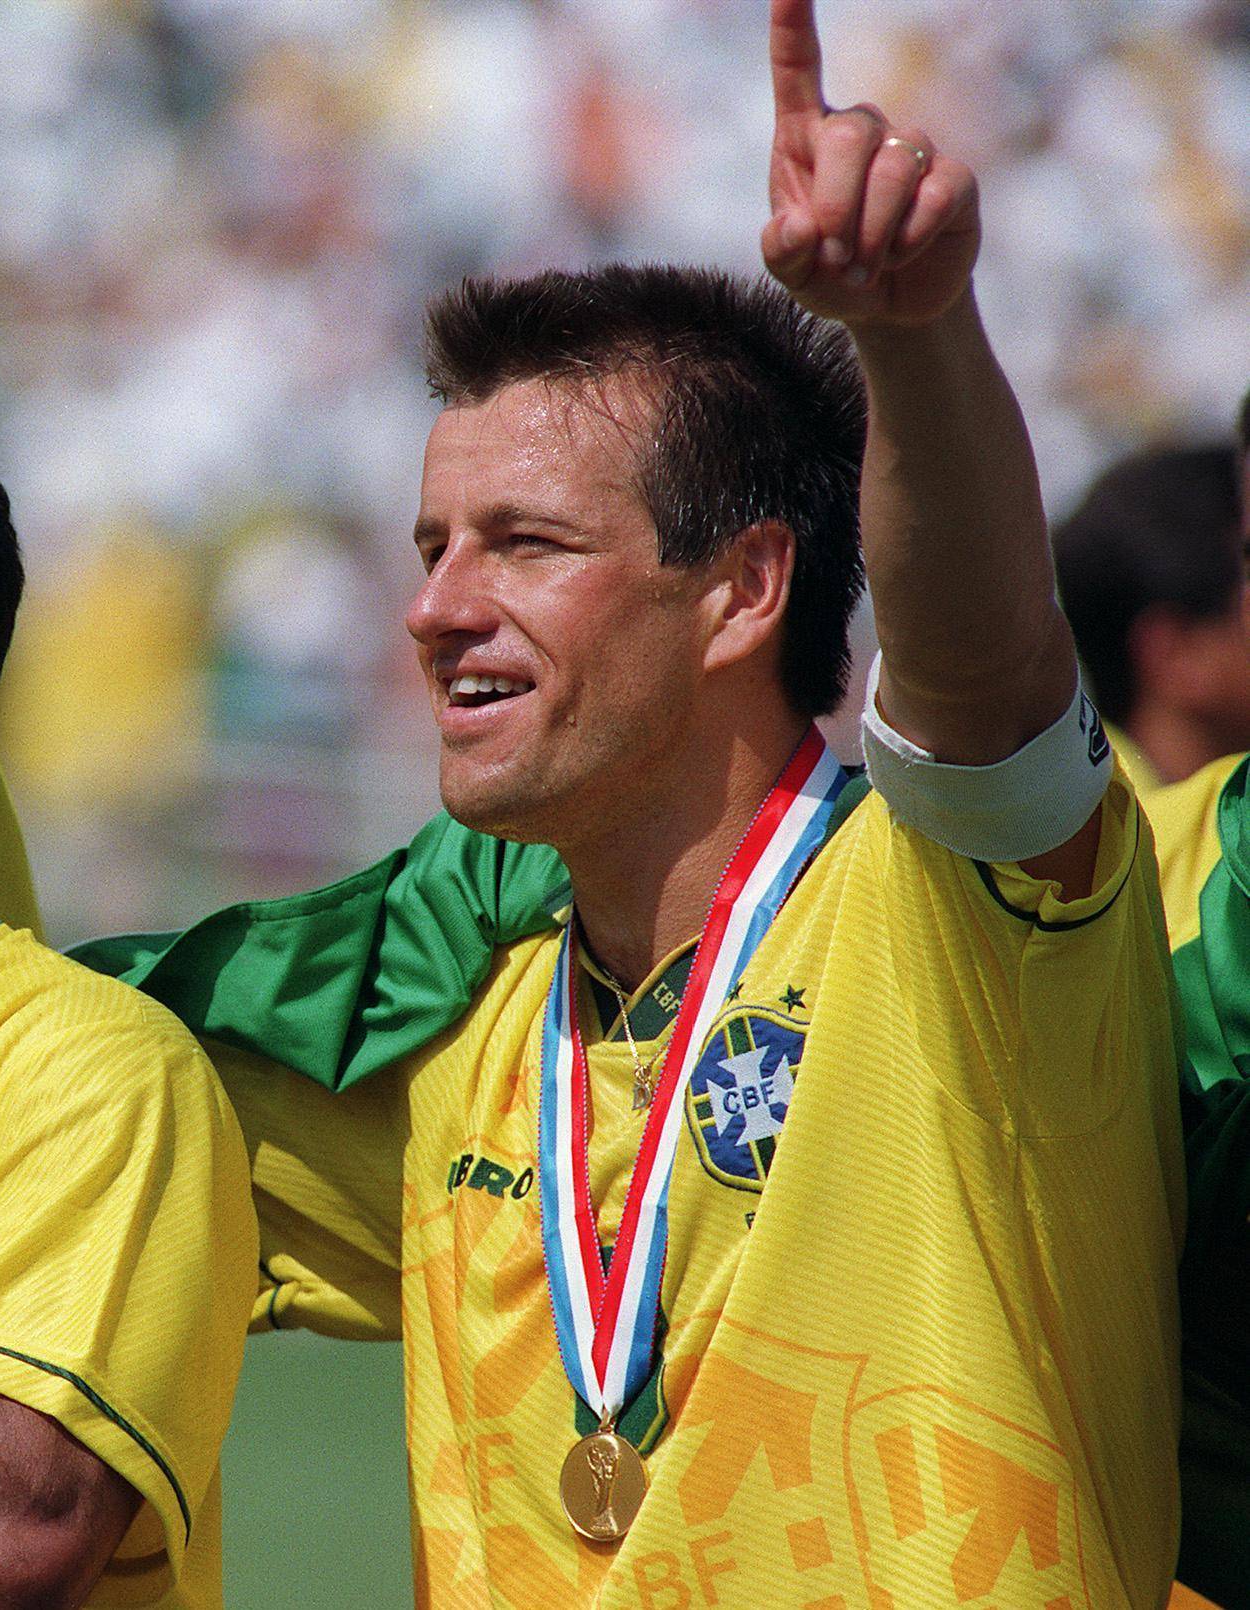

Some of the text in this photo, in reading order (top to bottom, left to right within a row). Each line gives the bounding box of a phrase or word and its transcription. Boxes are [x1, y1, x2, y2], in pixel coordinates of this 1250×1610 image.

[723, 1080, 775, 1114] CBF
[446, 1154, 534, 1200] BRO
[613, 1530, 737, 1610] BF
